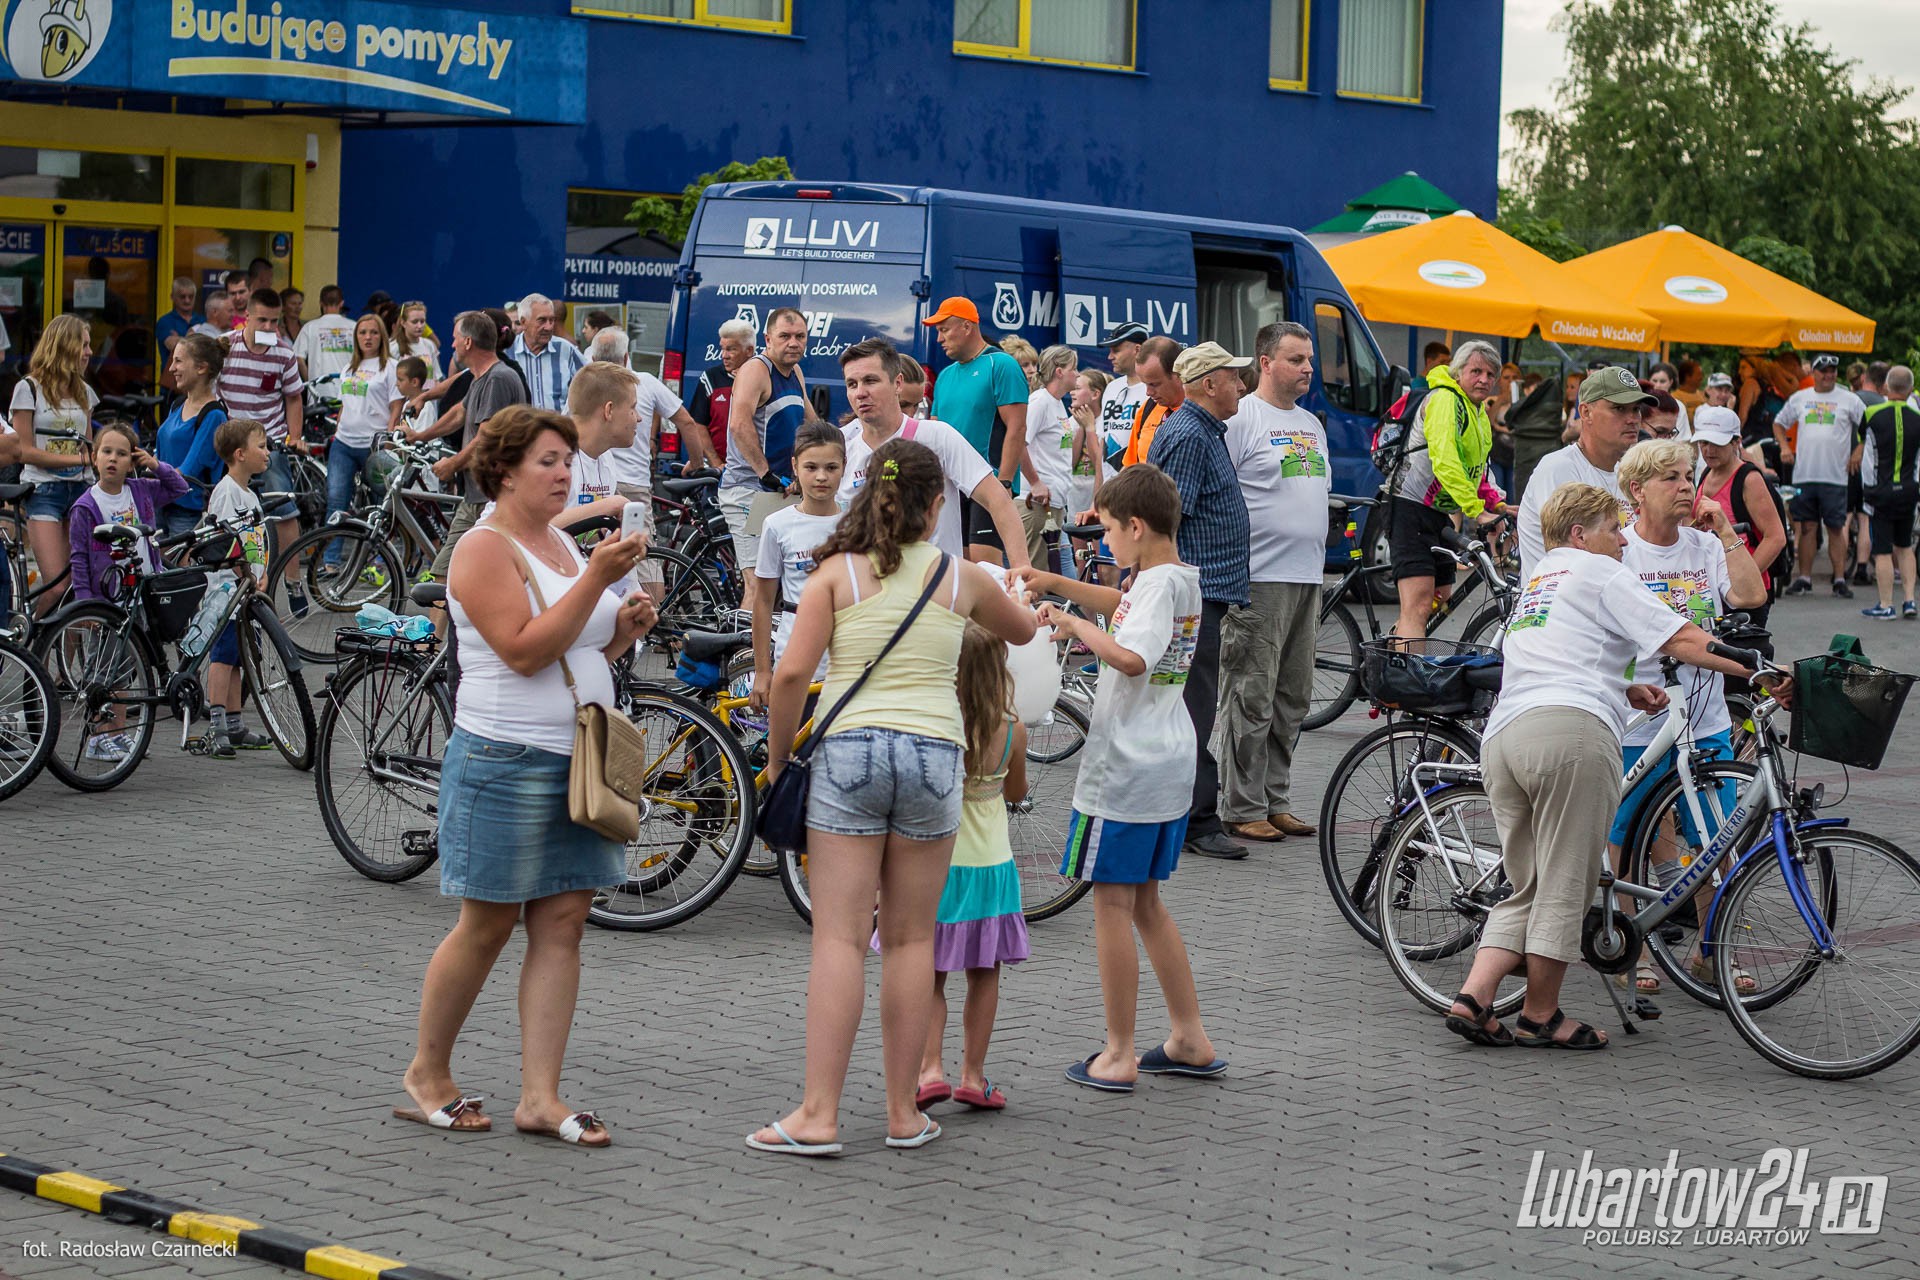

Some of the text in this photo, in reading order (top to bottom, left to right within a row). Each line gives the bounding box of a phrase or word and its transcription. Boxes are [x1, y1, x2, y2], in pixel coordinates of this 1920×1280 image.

[171, 0, 513, 80] Budujące pomysły
[783, 218, 879, 248] LUVI
[804, 249, 829, 258] BUILD
[830, 251, 875, 259] TOGETHER
[564, 258, 604, 275] PŁYTKI
[570, 278, 619, 298] ŚCIENNE
[717, 283, 878, 296] AUTORYZOWANY DOSTAWCA
[1102, 296, 1188, 336] LUVI
[1601, 325, 1646, 343] Wschód
[1103, 399, 1140, 421] Beat
[1661, 806, 1747, 907] KETTLER ALU-RAD
